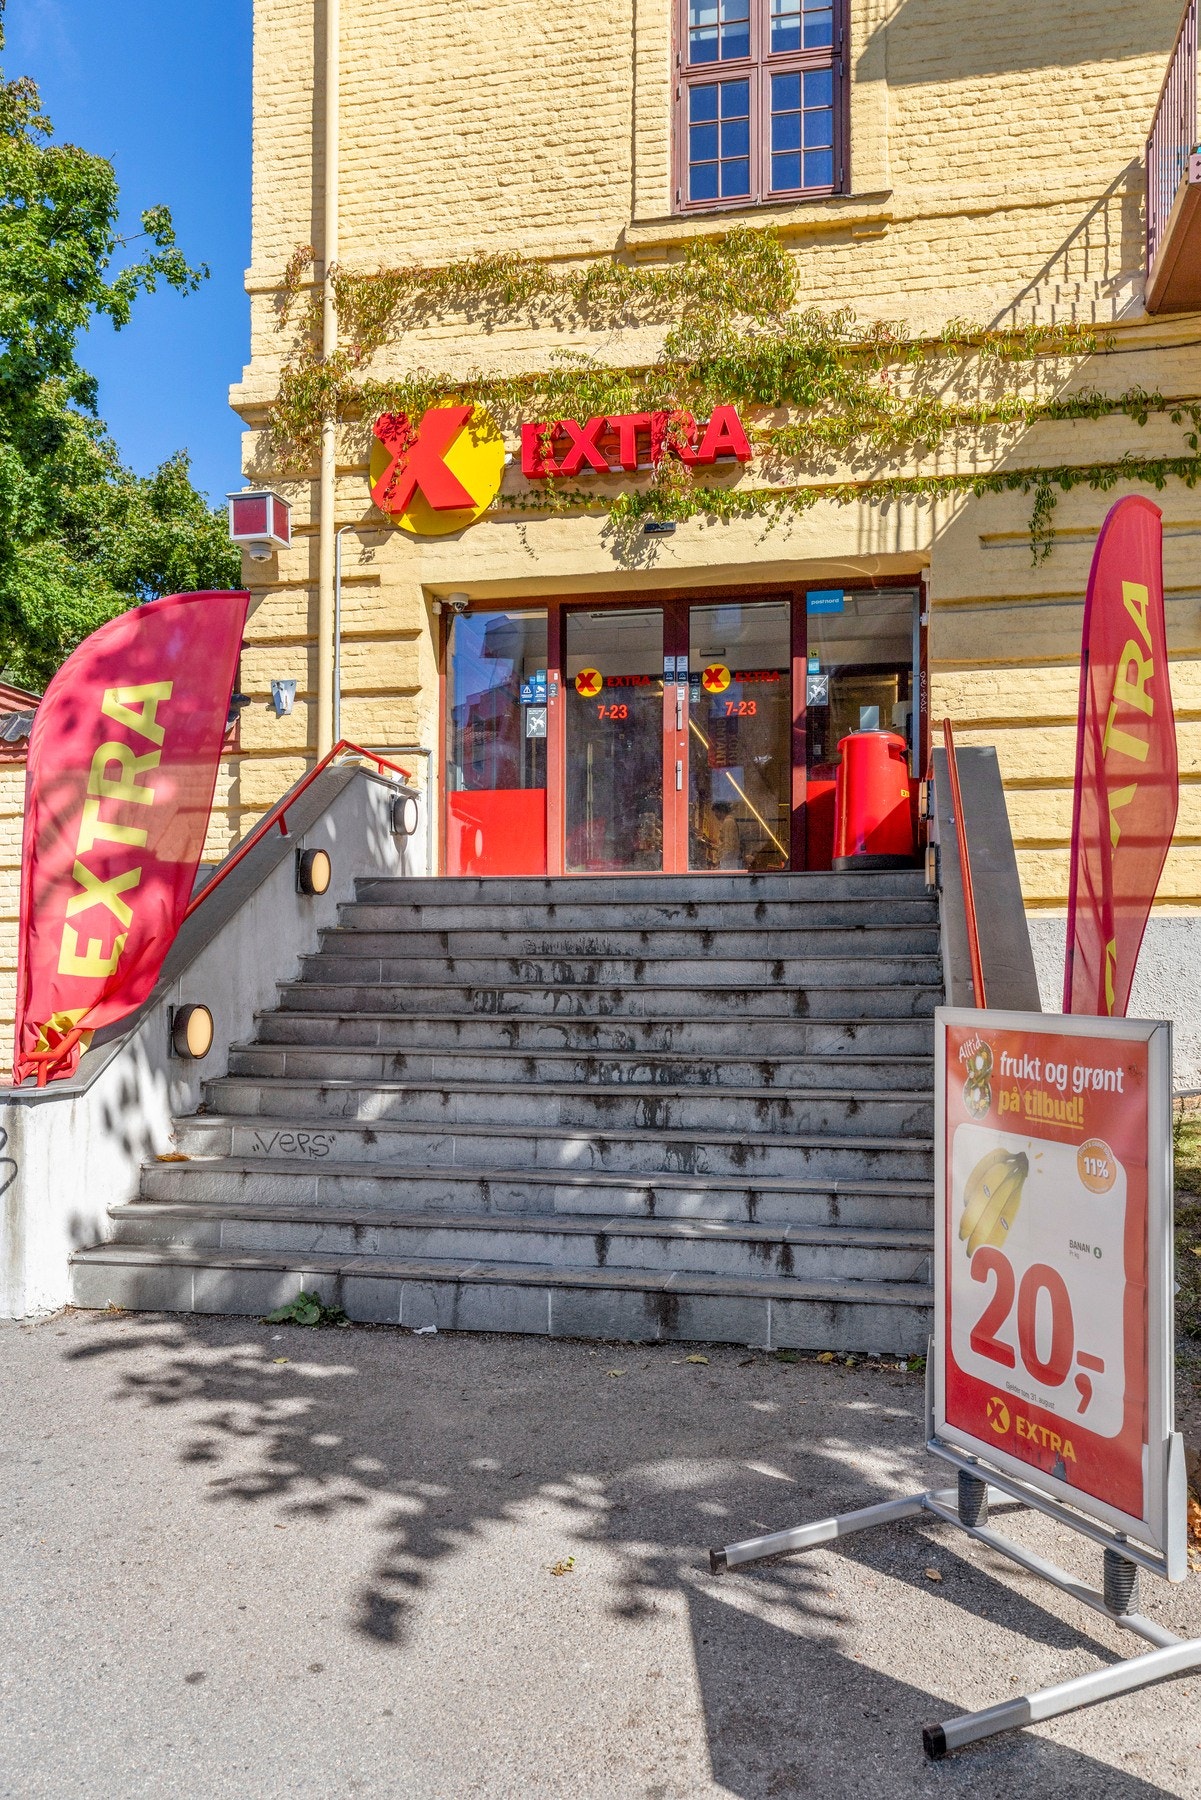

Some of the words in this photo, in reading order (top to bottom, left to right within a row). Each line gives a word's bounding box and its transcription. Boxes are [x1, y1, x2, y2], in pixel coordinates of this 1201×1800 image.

[521, 405, 752, 479] EXTRA
[607, 675, 651, 687] EXTRA
[735, 671, 781, 682] EXTRA
[597, 704, 628, 720] 7-23
[725, 701, 757, 716] 7-23
[716, 719, 727, 766] ONTANT
[57, 681, 174, 978] EXTRA
[959, 1032, 982, 1063] Alltid
[1000, 1051, 1041, 1082] frukt
[1045, 1063, 1068, 1091] og
[1072, 1065, 1124, 1093] grønt
[998, 1087, 1020, 1115] på
[1024, 1088, 1084, 1124] tilbud!
[1084, 1156, 1109, 1178] 11%
[1069, 1239, 1090, 1253] BANAN
[1016, 1415, 1077, 1463] EXTRA
